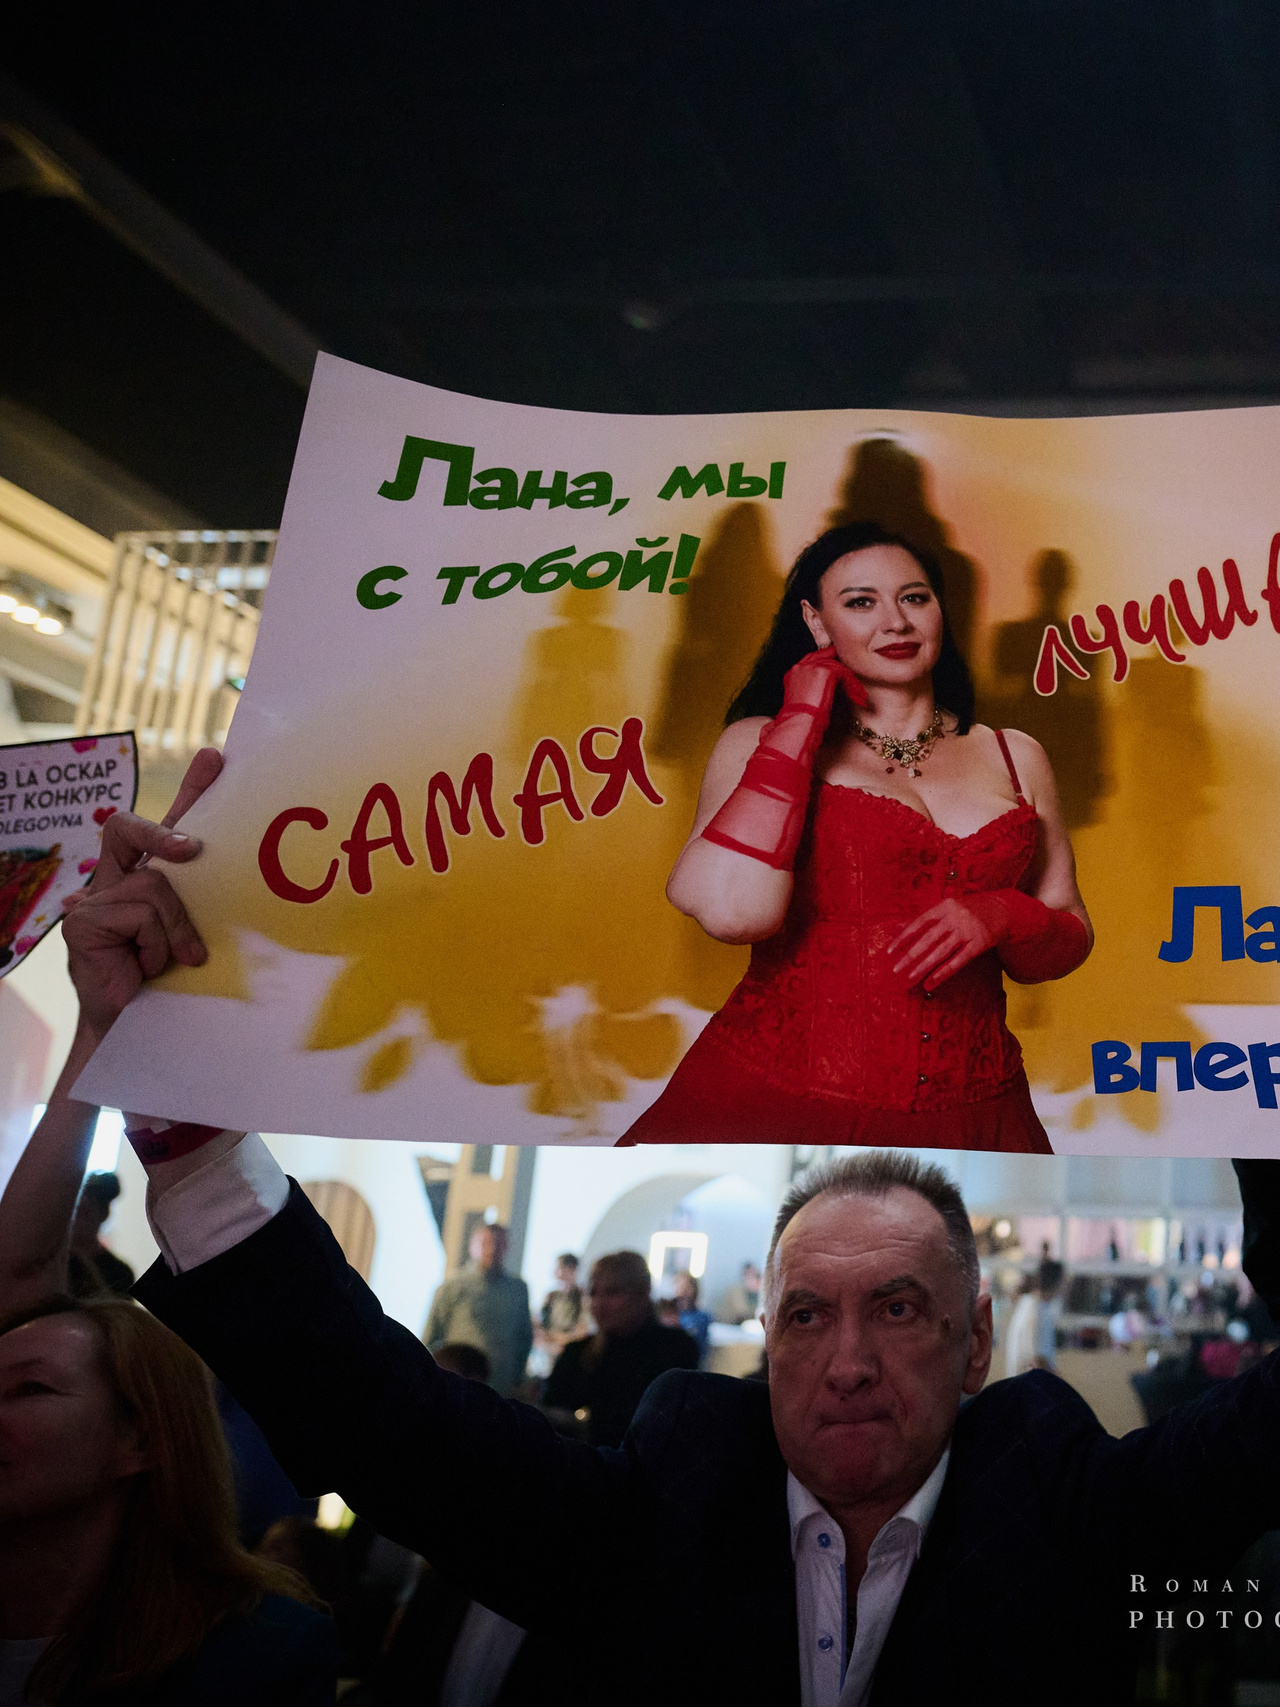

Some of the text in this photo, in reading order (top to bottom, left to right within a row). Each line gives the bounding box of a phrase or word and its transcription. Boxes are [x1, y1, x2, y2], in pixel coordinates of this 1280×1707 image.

[379, 436, 786, 516] Лана, мы
[357, 533, 701, 610] с тобой!
[24, 782, 122, 811] КОНКУРС
[46, 759, 117, 784] ОСКАР
[258, 717, 664, 904] САМАЯ
